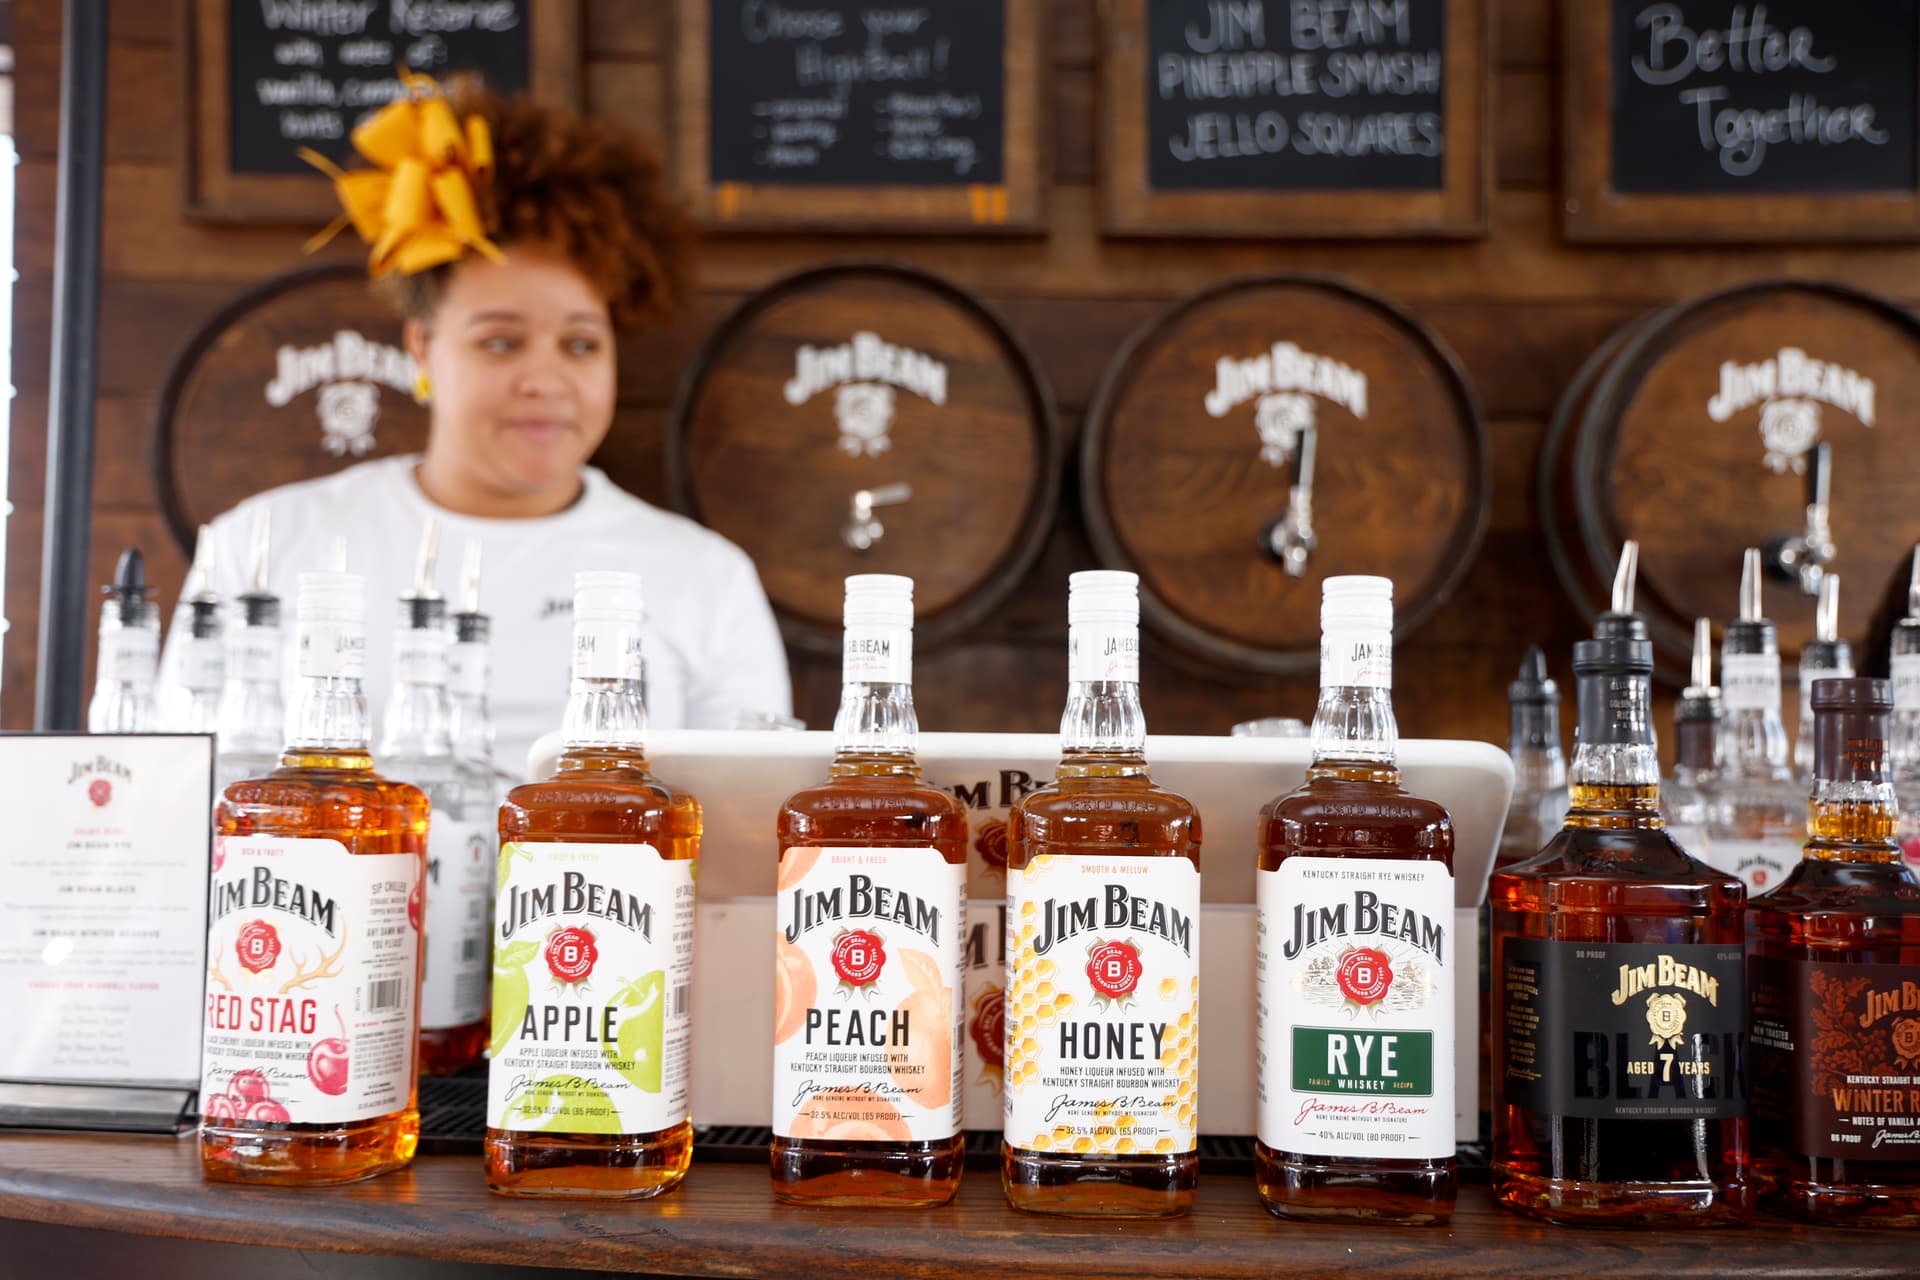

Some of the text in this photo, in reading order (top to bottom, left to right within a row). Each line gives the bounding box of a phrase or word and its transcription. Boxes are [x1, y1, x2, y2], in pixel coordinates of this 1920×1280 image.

[1185, 0, 1410, 52] JIM BEAM
[1632, 3, 1837, 85] Better
[1158, 49, 1441, 99] PINEAPPLE SMASH
[1169, 110, 1442, 161] JELLO SQUARES
[1680, 86, 1889, 176] Together
[265, 343, 334, 407] JIM
[784, 331, 947, 405] JIM BEAM
[1205, 341, 1368, 419] JIM BEAM
[1707, 347, 1876, 428] JIM BEAM
[866, 856, 887, 864] FRESH
[1081, 865, 1149, 874] SMOOTH & MELLOW
[1303, 870, 1425, 882] KENTUCKY STRAIGHT RYE WHISKEY
[252, 866, 336, 938] BEAM
[502, 884, 557, 940] JIM
[563, 872, 652, 944] BEAM
[786, 887, 843, 944] JIM
[849, 874, 939, 947] BEAM
[1033, 897, 1098, 956] JIM
[1104, 884, 1191, 959] BEAM
[1283, 891, 1443, 966] JIM BEAM
[251, 938, 263, 954] B
[564, 946, 578, 962] B
[851, 949, 864, 965] B
[1586, 951, 1606, 959] PROOF
[1107, 961, 1121, 977] B
[1357, 968, 1371, 984] B
[1611, 955, 1718, 1007] JIM BEAM
[208, 995, 317, 1034] RED STAG
[1662, 1010, 1671, 1021] B
[1859, 989, 1899, 1028] JIM
[520, 1005, 618, 1042] APPLE
[806, 1008, 910, 1046] PEACH
[1766, 1028, 1789, 1041] TOASTED
[520, 1048, 618, 1059] APPLE LIQUEUR INFUSED WITH
[1060, 1022, 1167, 1060] HONEY
[504, 1059, 635, 1071] KENTUCKY STRAIGHT BOURBON WHISKEY
[791, 1064, 925, 1074] KENTUCKY STRAIGHT BOURBON WHISKEY
[806, 1052, 908, 1062] PEACH LIQUEUR INFUSED WITH
[1327, 1034, 1398, 1077] RYE
[1627, 1053, 1710, 1082] AGED 7 YEARS
[1043, 1078, 1180, 1088] KENTUCKY STRAIGHT BOURBON WHISKEY
[1060, 1066, 1165, 1077] HONEY LIQUEUR INFUSED WITH
[1309, 1078, 1331, 1086] FAMILY
[1338, 1080, 1385, 1090] WHISKEY
[1847, 1075, 1910, 1085] KENTUCKY STRAIGHT
[792, 1080, 853, 1107] James
[873, 1082, 923, 1094] Beam
[1832, 1088, 1904, 1113] WINTER
[1045, 1094, 1111, 1122] James
[1131, 1096, 1177, 1108] Beam
[1294, 1098, 1358, 1126] James
[1382, 1102, 1428, 1114] Beam
[1852, 1117, 1914, 1126] NOTES OF VANILLA
[1066, 1126, 1088, 1135] 32.5%
[1089, 1127, 1117, 1135] ALC/VOL
[1319, 1131, 1334, 1139] 40%
[1336, 1131, 1364, 1141] ALC/VOL
[1842, 1135, 1861, 1143] PROOF
